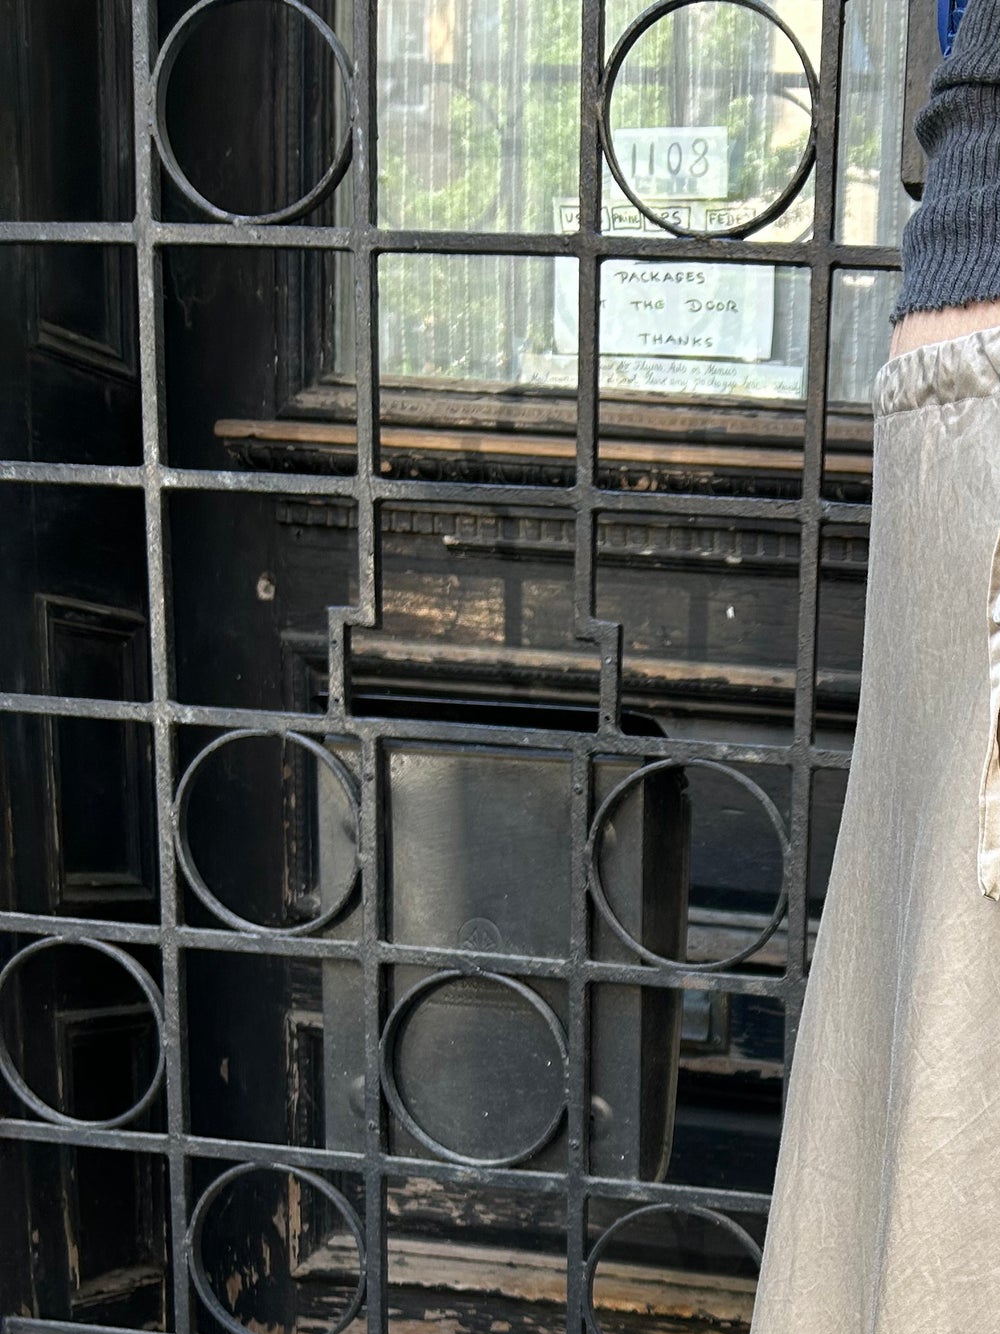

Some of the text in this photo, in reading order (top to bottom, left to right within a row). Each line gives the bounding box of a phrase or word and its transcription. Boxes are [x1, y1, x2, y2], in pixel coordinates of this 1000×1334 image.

[630, 137, 709, 179] 1108
[614, 270, 706, 285] PACKAGES
[629, 299, 666, 312] THE
[685, 298, 739, 313] DOOR
[638, 332, 713, 348] THANKS
